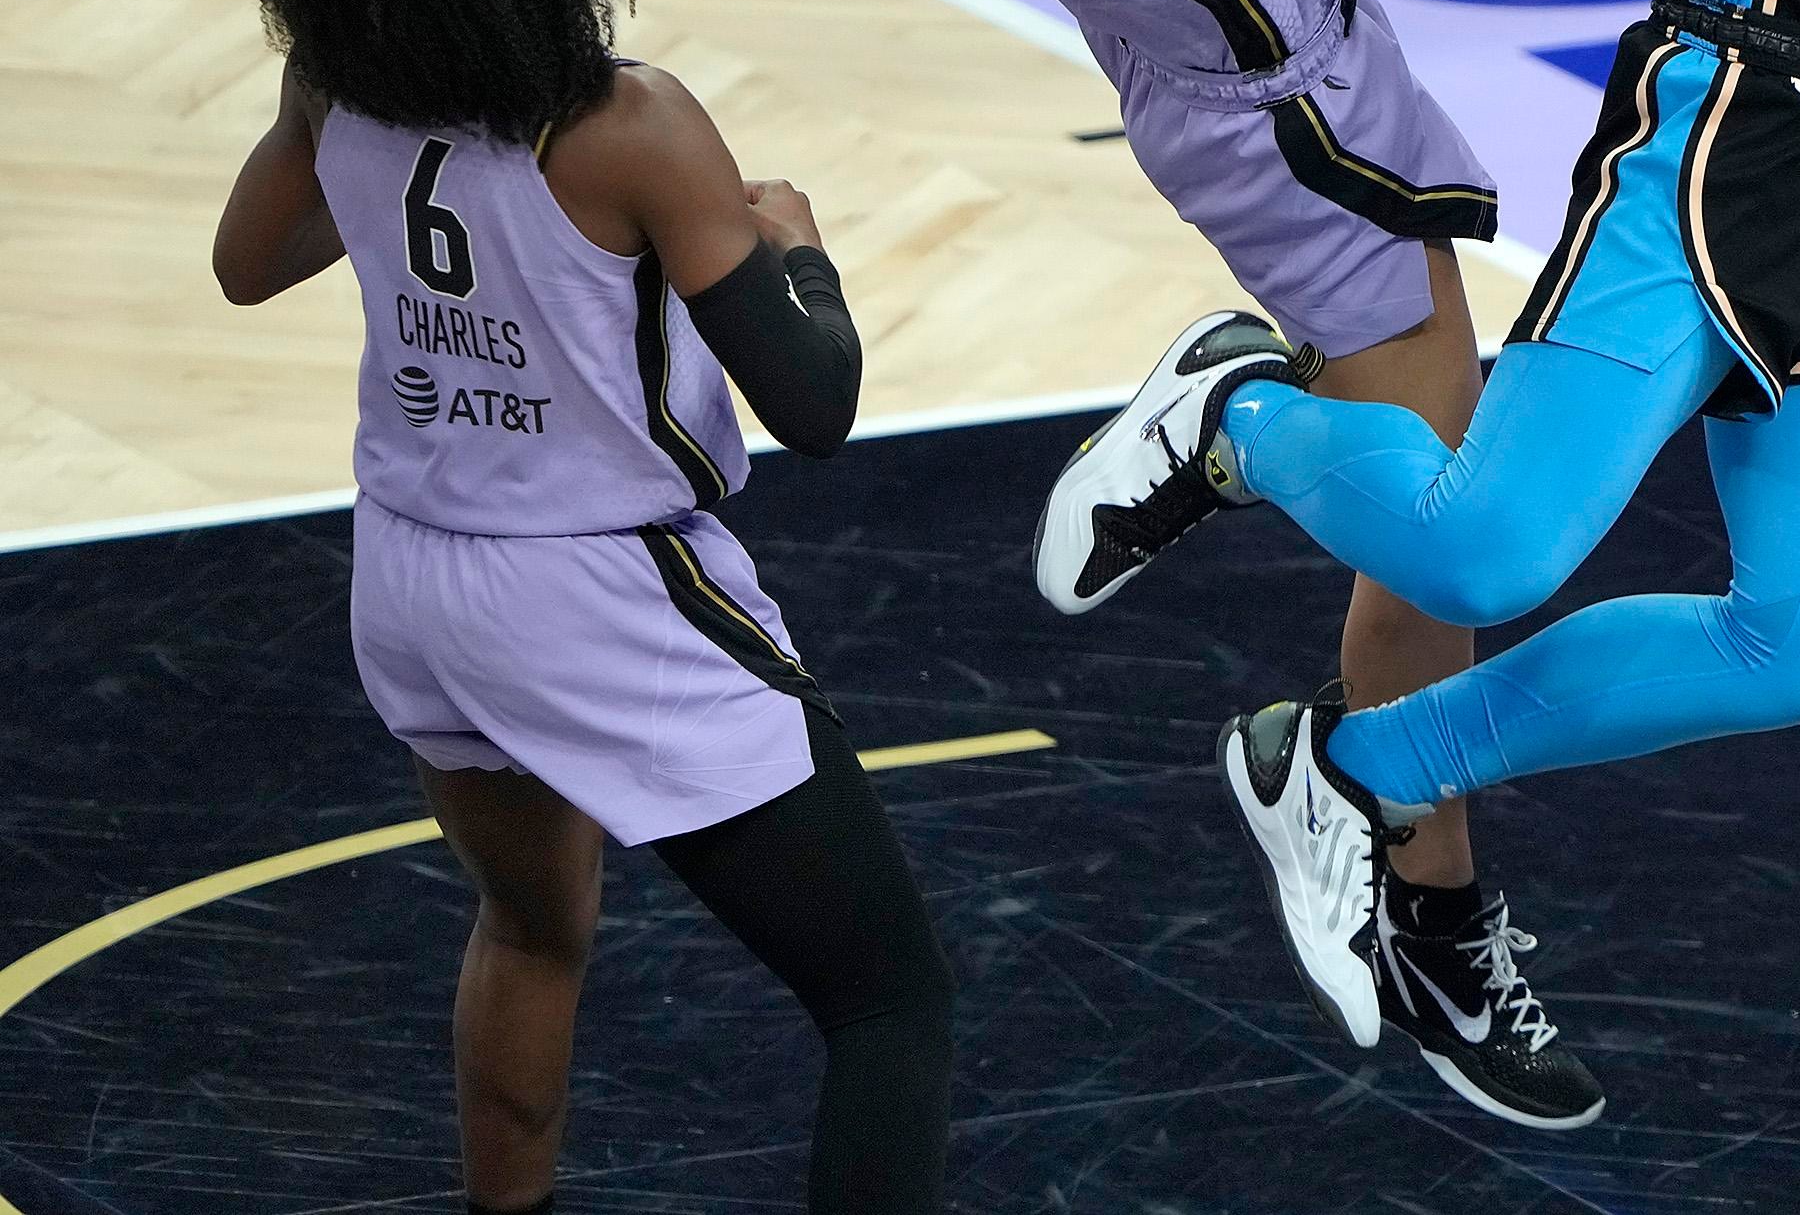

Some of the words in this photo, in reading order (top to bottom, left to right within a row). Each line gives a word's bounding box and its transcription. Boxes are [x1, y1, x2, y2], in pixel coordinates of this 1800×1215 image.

[401, 135, 478, 301] 6
[396, 293, 526, 370] CHARLES
[447, 387, 552, 435] AT&T
